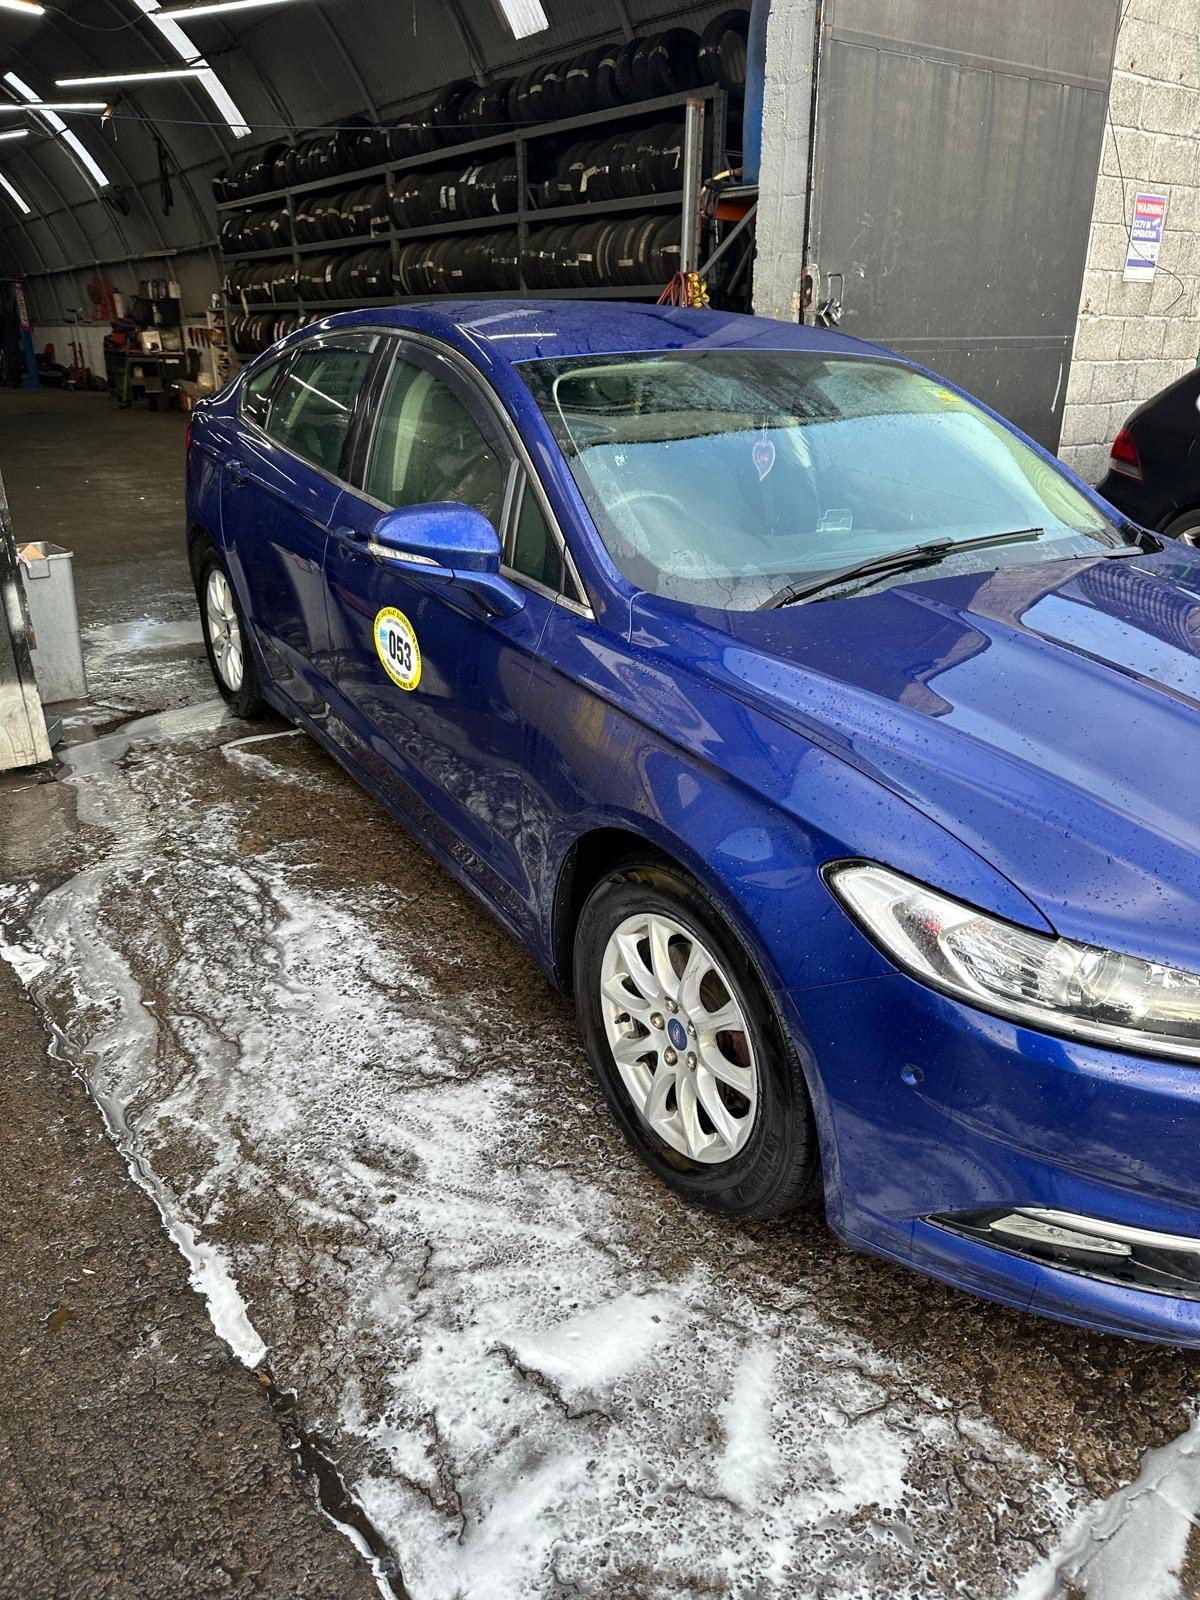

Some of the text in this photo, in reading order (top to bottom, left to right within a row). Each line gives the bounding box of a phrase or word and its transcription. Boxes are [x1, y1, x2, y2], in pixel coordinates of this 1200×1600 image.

[1137, 202, 1164, 215] WARNING
[1135, 220, 1146, 229] CCTV
[1133, 229, 1157, 239] OPERATION
[389, 629, 411, 672] 053
